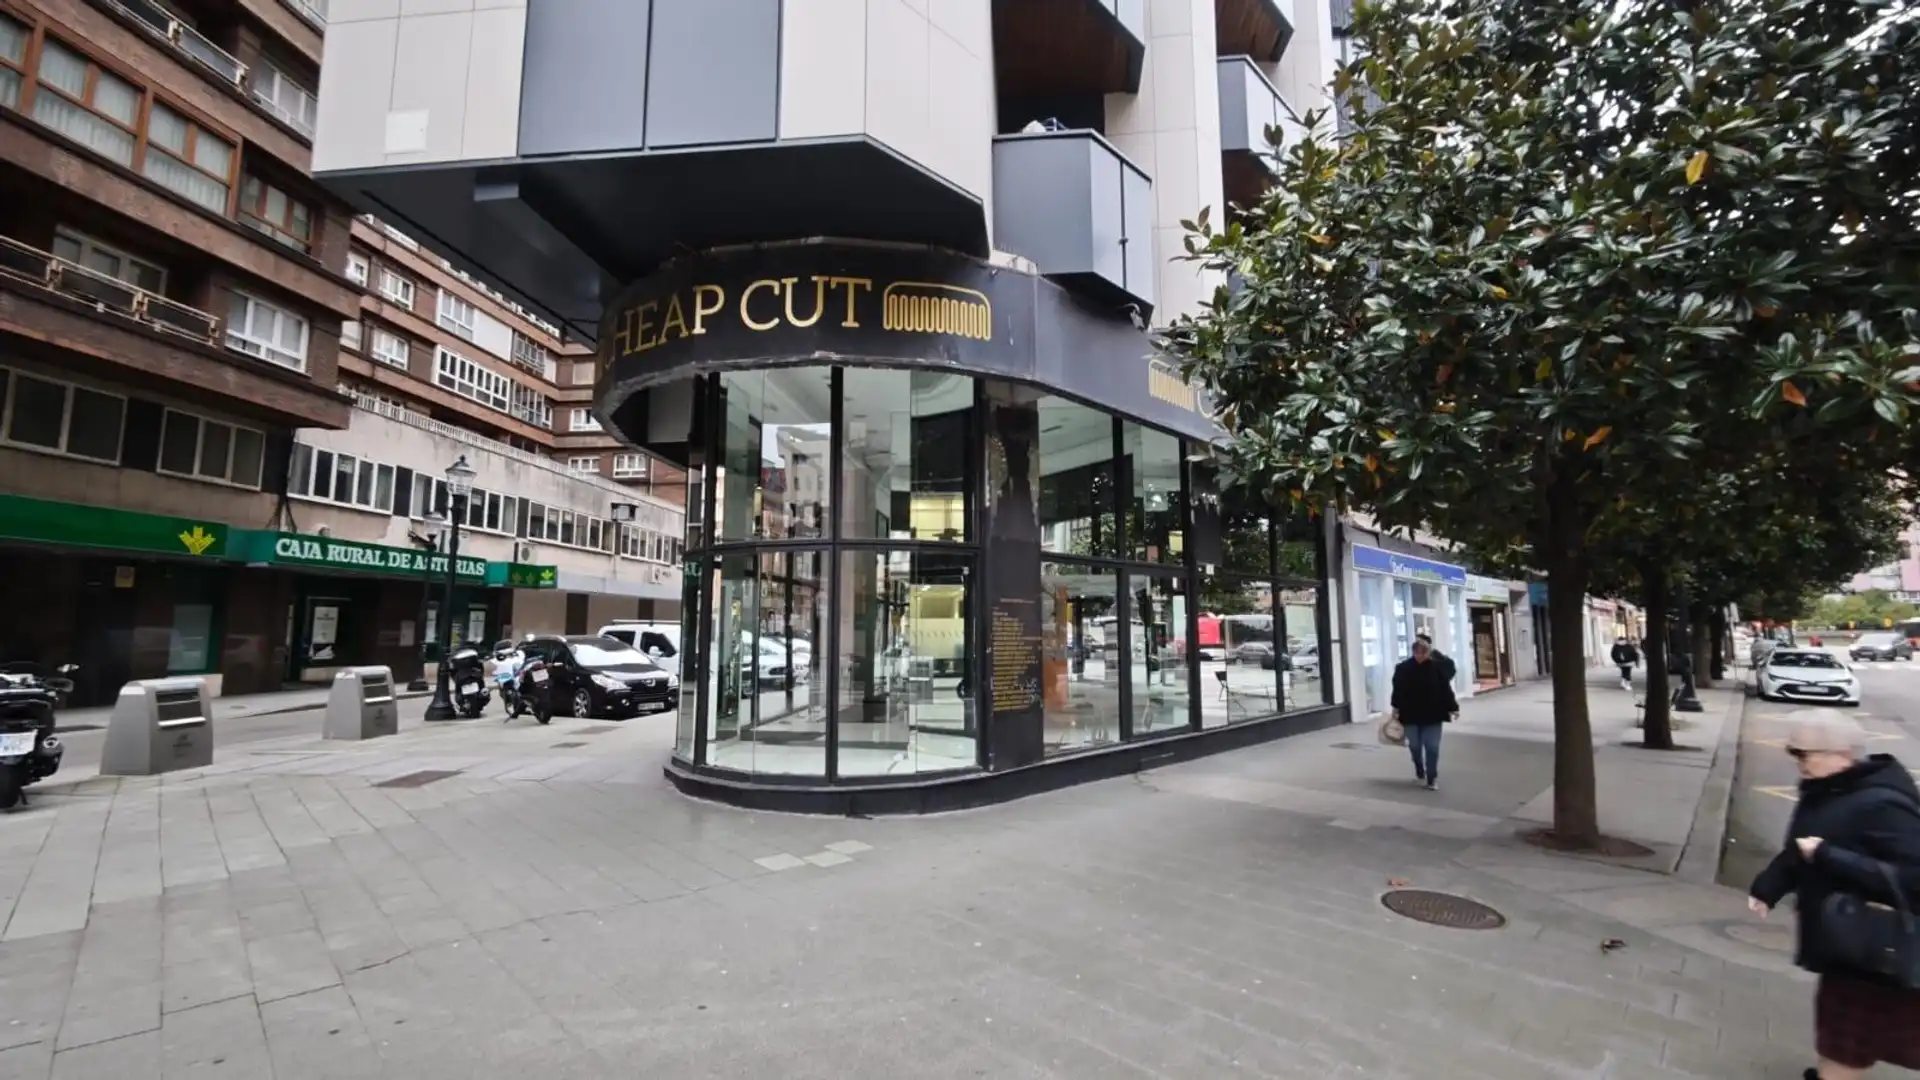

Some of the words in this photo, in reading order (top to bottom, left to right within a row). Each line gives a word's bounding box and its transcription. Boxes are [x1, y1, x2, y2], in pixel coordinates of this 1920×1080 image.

[604, 284, 725, 370] HEAP
[740, 275, 872, 331] CUT
[275, 537, 323, 560] CAJA
[327, 543, 385, 567] RURAL
[387, 551, 411, 568] DE
